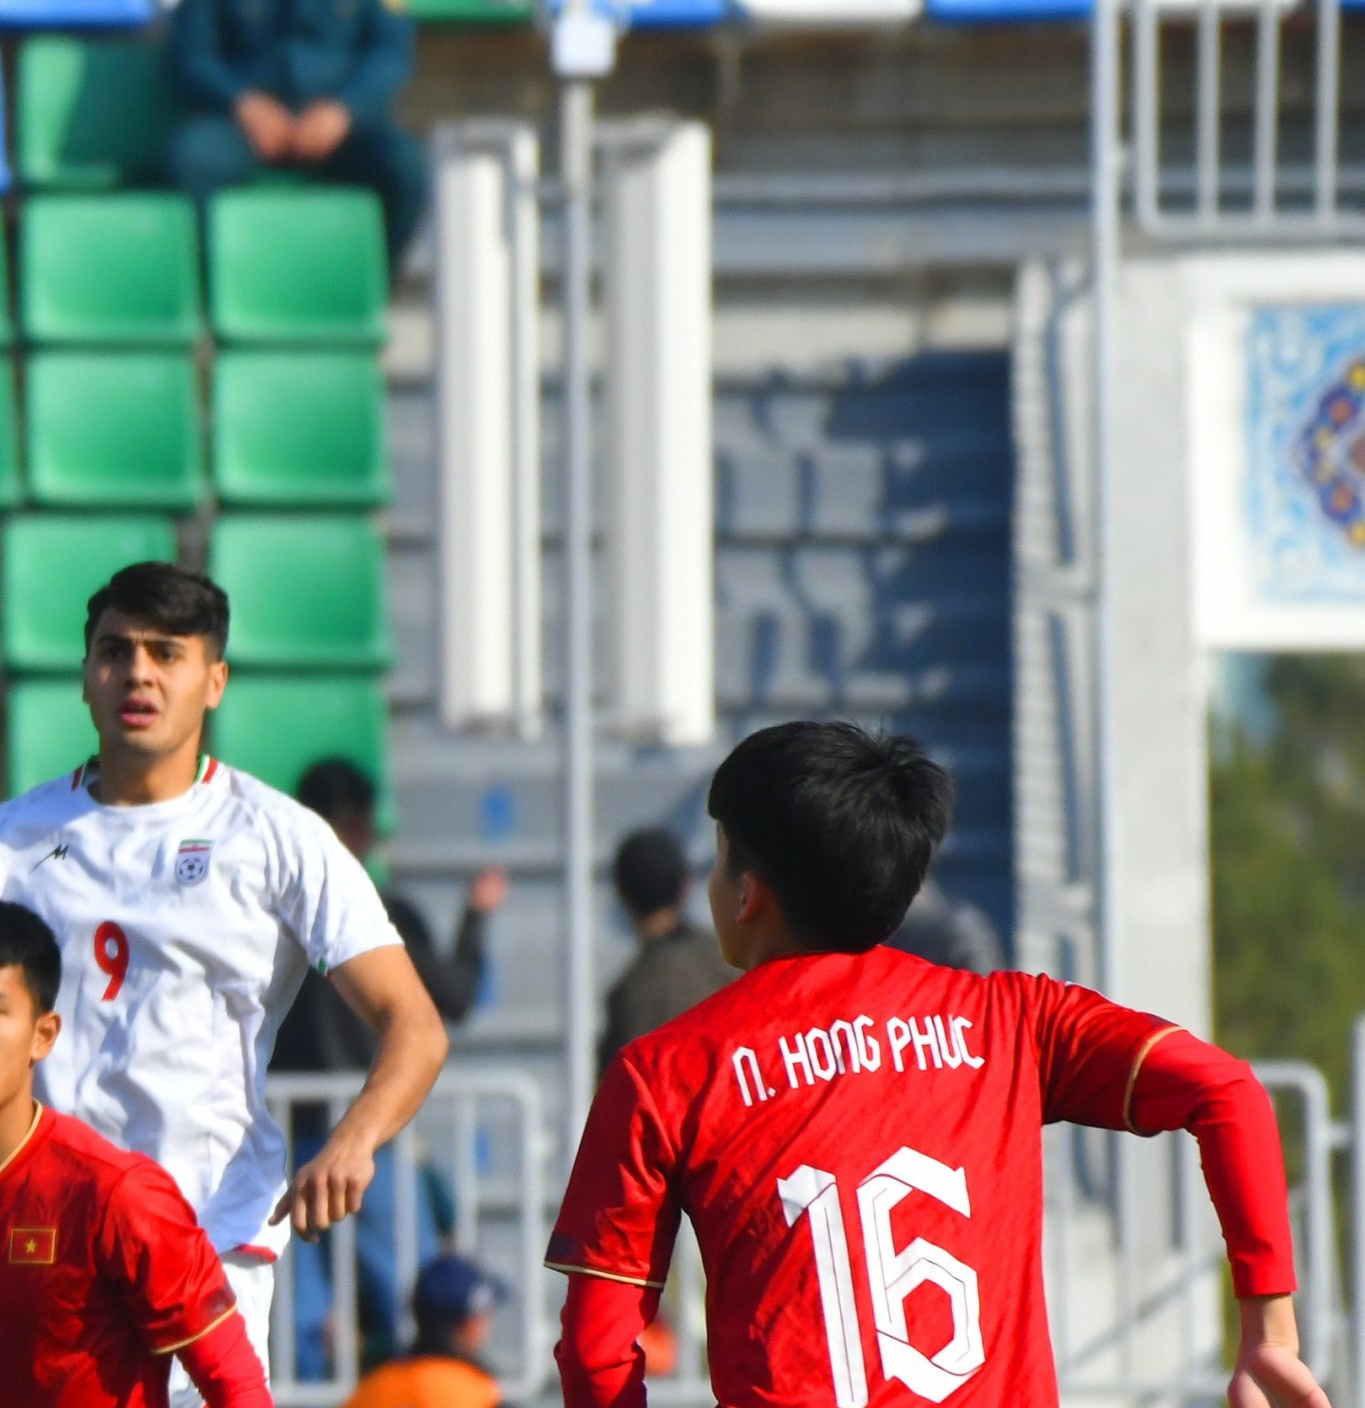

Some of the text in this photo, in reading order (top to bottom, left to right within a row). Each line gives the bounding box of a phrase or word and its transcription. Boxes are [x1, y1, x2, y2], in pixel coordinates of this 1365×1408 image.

[94, 921, 130, 1002] 9
[778, 1014, 882, 1089] HONG
[886, 1013, 986, 1072] PHUC
